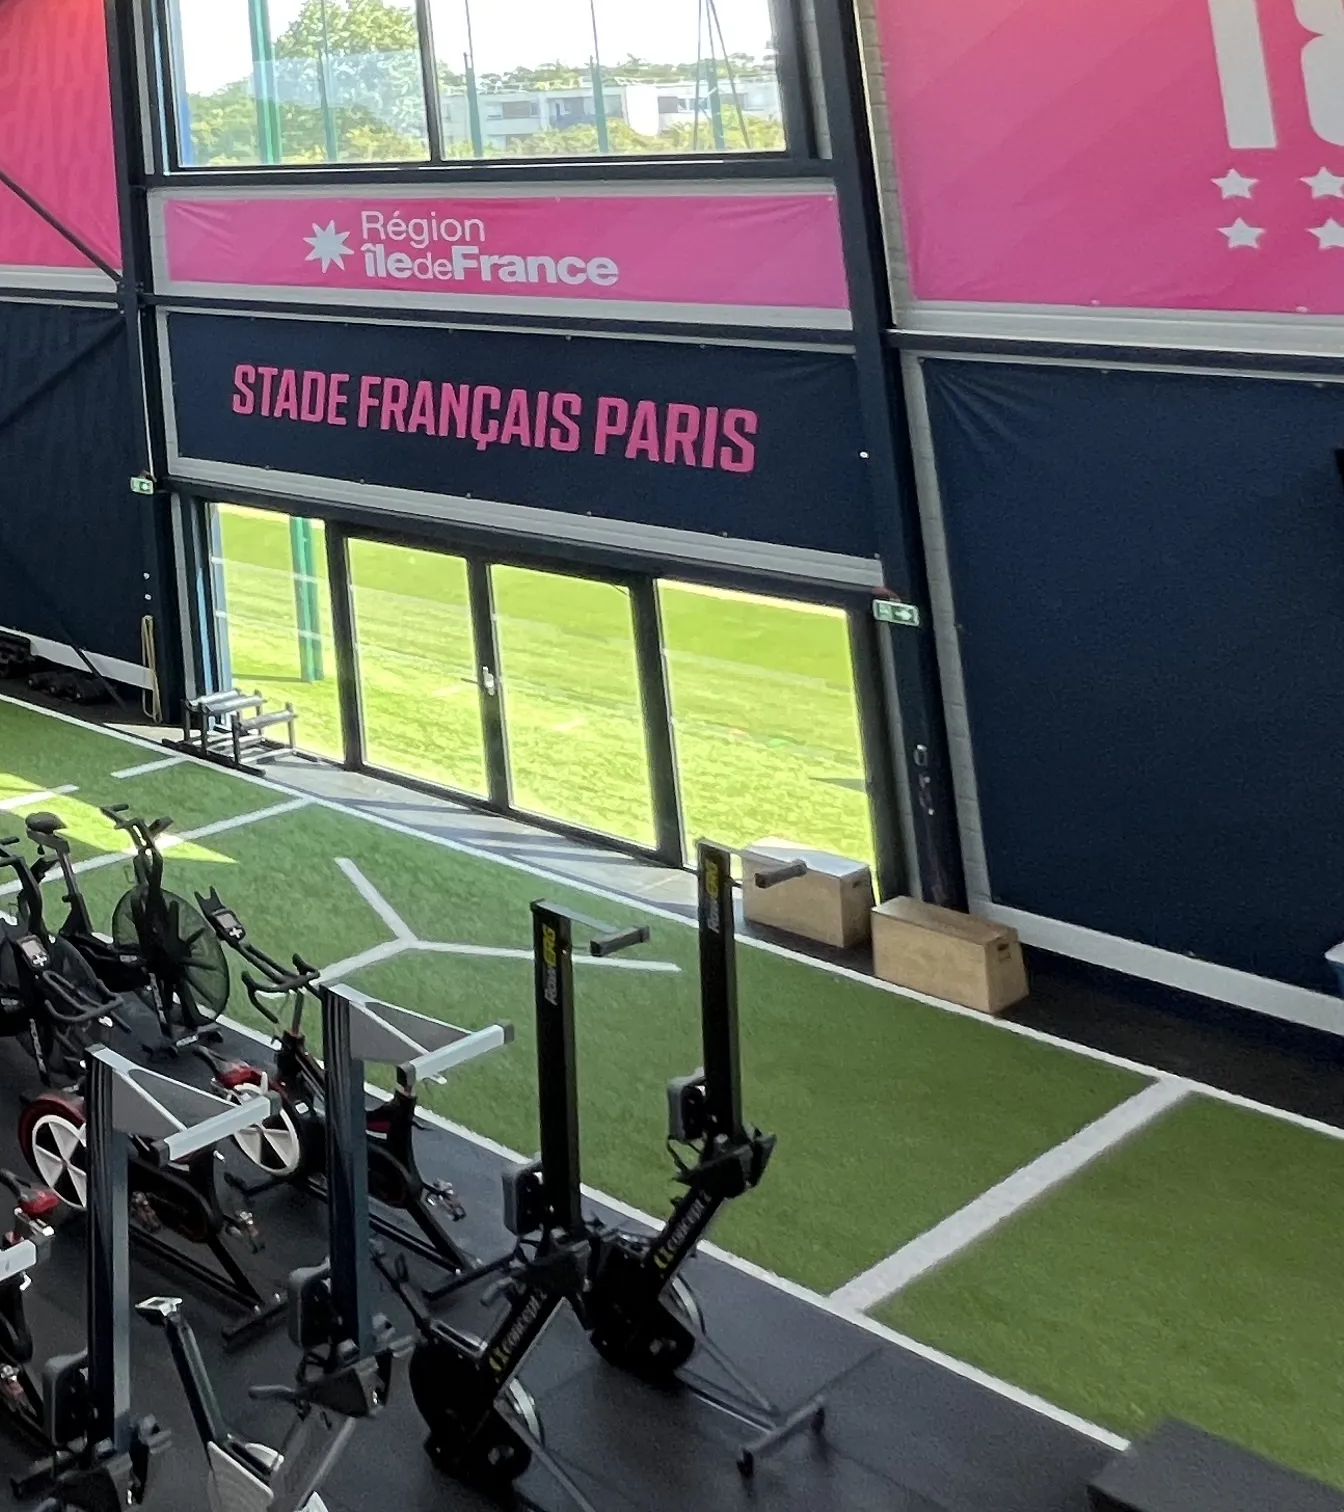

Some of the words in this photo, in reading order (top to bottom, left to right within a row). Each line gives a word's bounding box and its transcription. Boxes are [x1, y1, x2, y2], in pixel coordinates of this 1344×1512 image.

[360, 210, 486, 249] Région
[231, 364, 350, 427] STADE
[356, 375, 583, 452] FRANÇAIS
[593, 396, 759, 474] PARIS
